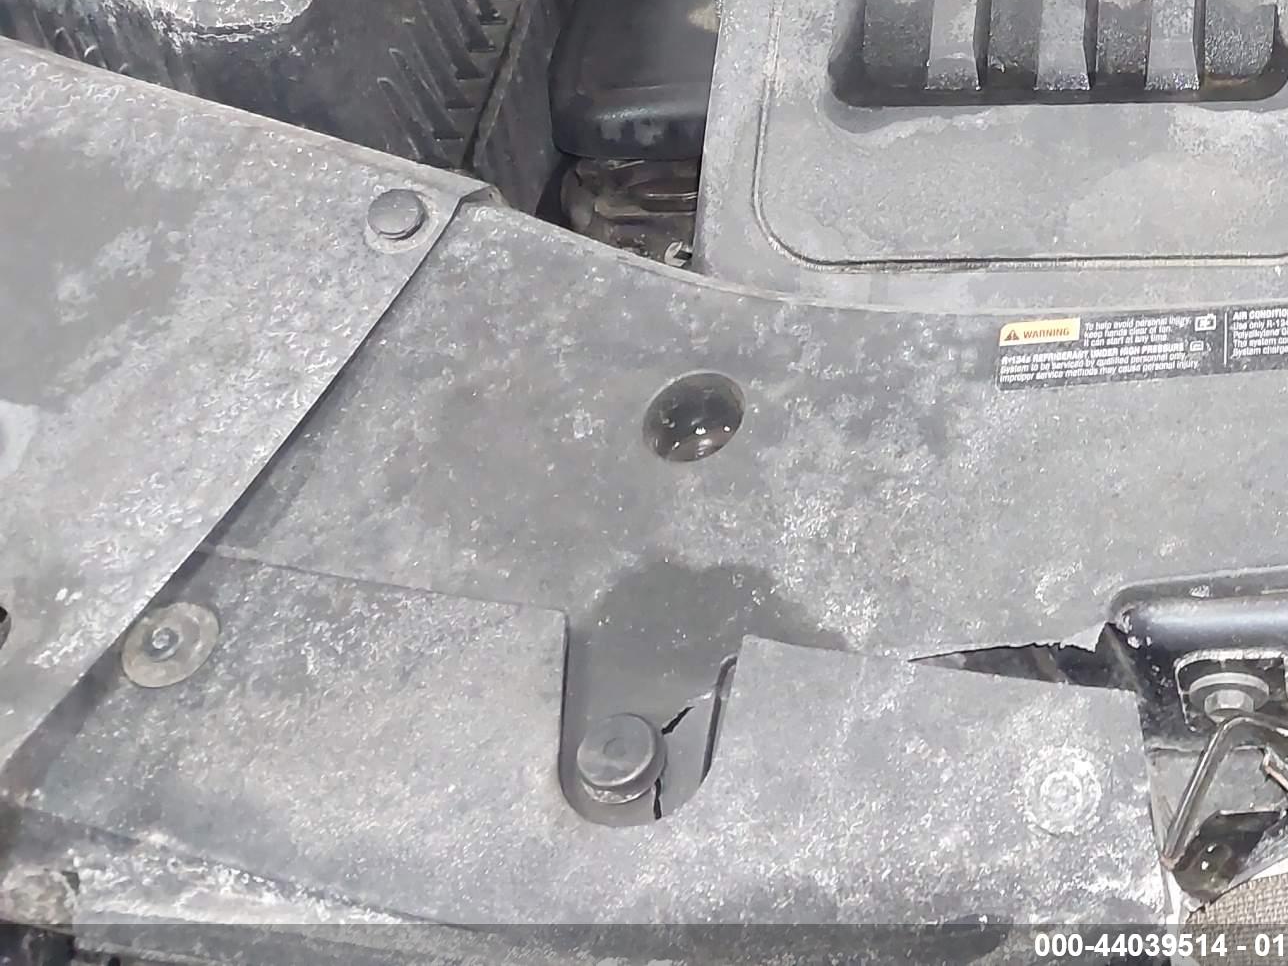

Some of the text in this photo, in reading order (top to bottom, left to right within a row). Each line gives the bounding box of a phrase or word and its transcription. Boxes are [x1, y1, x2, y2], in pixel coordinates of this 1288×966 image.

[1232, 311, 1248, 322] AIR
[1113, 320, 1134, 329] avoid
[1135, 317, 1168, 329] personal
[1233, 322, 1247, 331] Use
[1249, 321, 1265, 331] only
[1023, 327, 1070, 339] WARNING
[1233, 340, 1247, 348] The
[1248, 338, 1276, 349] system
[1032, 350, 1089, 363] REFRIGERANT
[1091, 348, 1118, 359] UNDER
[1120, 346, 1141, 356] HIGH
[1141, 343, 1184, 355] PRESSURE
[1232, 347, 1261, 358] System
[1052, 360, 1082, 370] serviced
[1096, 357, 1129, 368] qualified
[1130, 354, 1168, 365] personnel
[1000, 373, 1034, 384] Improper
[1036, 371, 1063, 380] service
[1065, 368, 1098, 377] methods
[1100, 368, 1117, 376] may
[1142, 362, 1175, 373] personal
